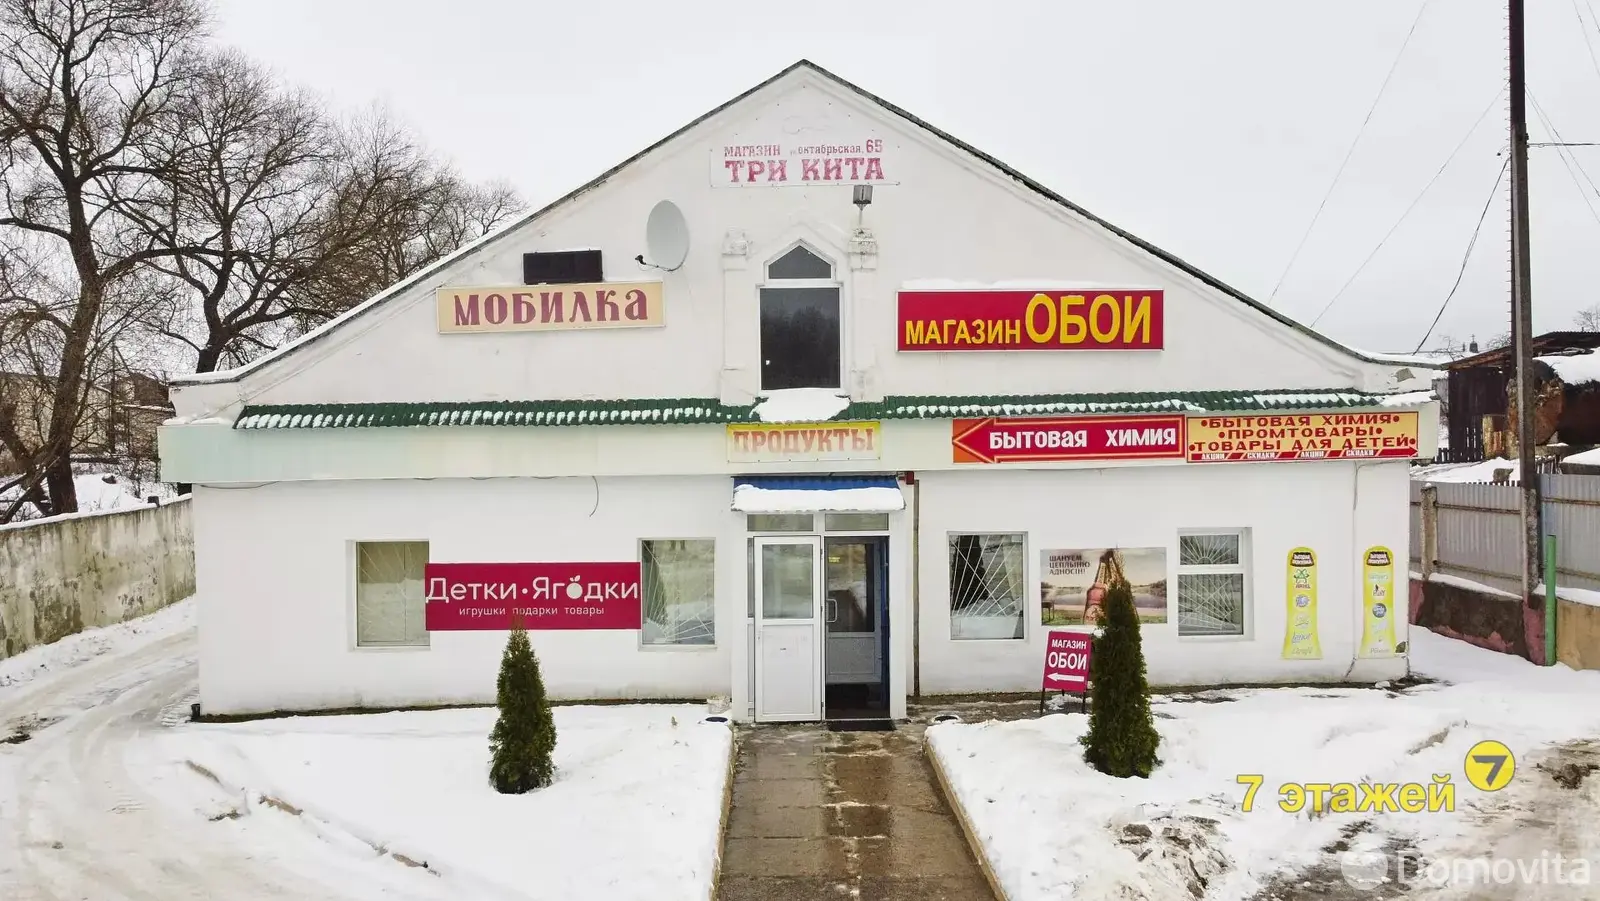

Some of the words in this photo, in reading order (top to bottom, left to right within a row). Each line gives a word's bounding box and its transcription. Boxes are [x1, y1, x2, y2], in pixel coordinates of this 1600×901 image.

[724, 144, 781, 157] МАГАЗИН
[866, 139, 883, 153] 65
[724, 160, 788, 182] ТРИ
[801, 157, 884, 181] КИТА
[905, 319, 1021, 345] МАГАЗИН
[1025, 293, 1151, 344] ОБОИ
[1209, 416, 1311, 428] БЫТОВАЯ
[1322, 414, 1393, 426] ХИМИЯ
[733, 428, 874, 454] ПРОДУКТЫ
[1105, 427, 1176, 447] ХИМИЯ
[1228, 426, 1374, 439] ПРОМТОВАРЫ
[1195, 440, 1281, 451] ТОВАРЫ
[1292, 438, 1332, 451] ДЛЯ
[1342, 433, 1409, 449] ДЕТЕЙ
[1247, 451, 1275, 459] СКИДКИ
[1300, 450, 1324, 458] АКЦИИ
[426, 577, 517, 603] Детки
[459, 607, 506, 617] игрушки
[512, 607, 558, 616] подарки
[564, 607, 604, 616] товары
[1051, 639, 1087, 650] МАГАЗИН
[1048, 652, 1087, 670] ОБОИ
